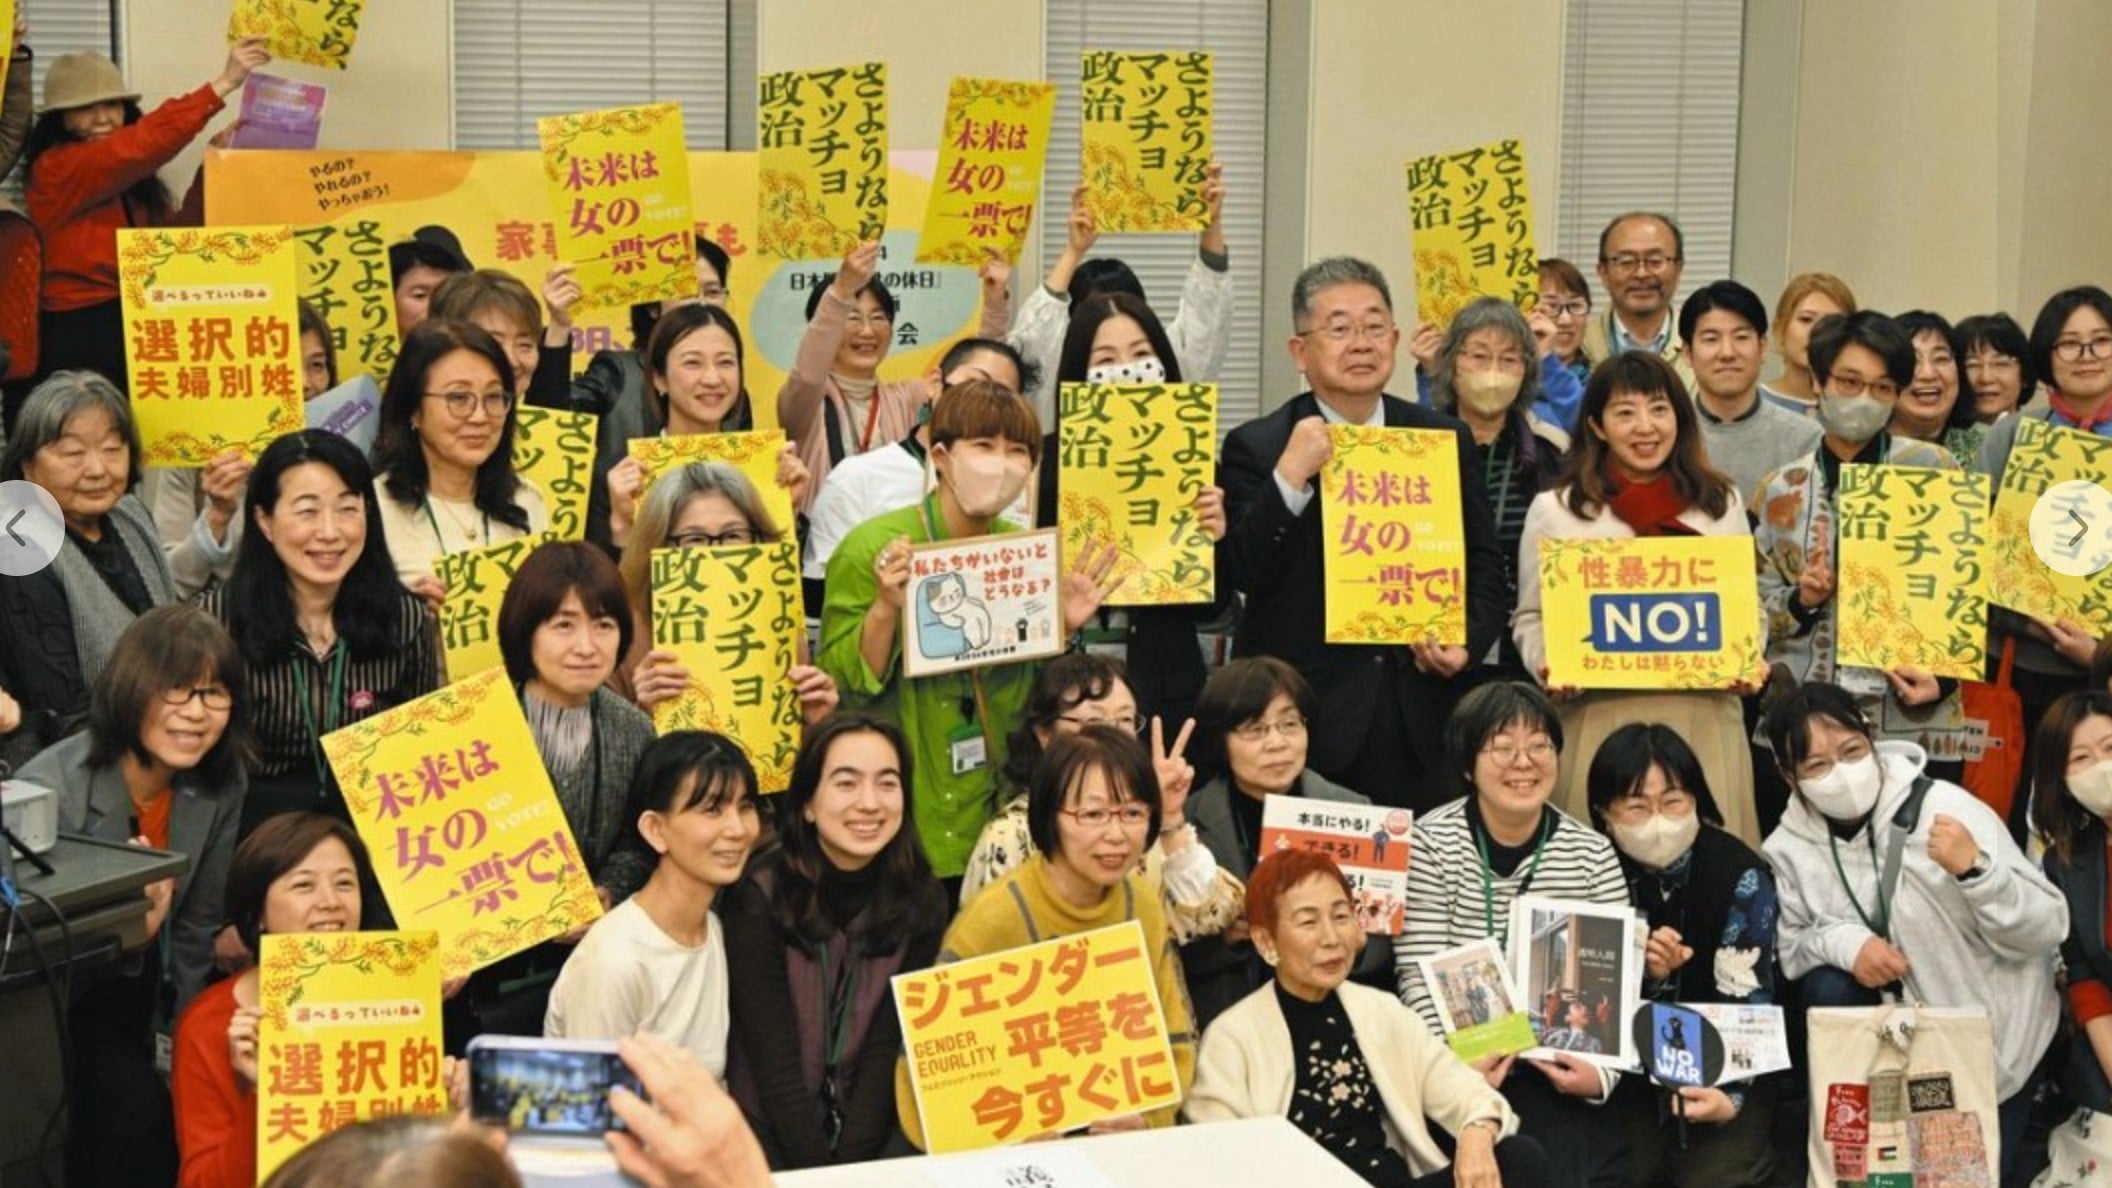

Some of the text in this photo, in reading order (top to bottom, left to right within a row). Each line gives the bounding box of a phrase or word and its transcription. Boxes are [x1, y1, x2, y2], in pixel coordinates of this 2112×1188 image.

[760, 71, 805, 148] 政治
[1082, 52, 1125, 122] 政治
[807, 67, 850, 194] マッチョ
[1128, 54, 1170, 169] マッチョ
[953, 118, 1029, 152] 未来は
[1174, 51, 1210, 229] さようなら、
[310, 158, 354, 178] やるの?
[314, 171, 371, 194] やれるの?
[563, 151, 659, 191] 未来は
[945, 157, 1005, 195] 女の
[1407, 156, 1451, 230] 政治
[1449, 148, 1495, 268] マッチョ
[565, 197, 640, 238] 女の
[572, 230, 692, 275] 一票で!
[132, 314, 290, 362] 選択的
[897, 322, 919, 345] 会
[136, 363, 297, 400] 夫婦別姓
[1061, 383, 1114, 468] 政治
[1115, 385, 1166, 527] マッチョ
[2004, 420, 2066, 497] 政治
[1336, 469, 1433, 507] 未来は
[1841, 465, 1891, 541] 政治
[1340, 514, 1411, 556] 女の
[1893, 469, 1942, 599] マッチョ
[914, 543, 1047, 577] 私たちがいないと
[984, 566, 1024, 583] 社会は
[1578, 556, 1717, 589] 性暴力に
[1945, 471, 1987, 679] さようなら、
[434, 550, 491, 650] 政治
[652, 548, 709, 644] 政治
[985, 578, 1051, 601] どうなる?
[1338, 563, 1461, 606] 一票で!
[711, 547, 765, 706] マッチョ
[1604, 601, 1708, 643] NO!
[1582, 655, 1724, 671] わたしは黙らない
[368, 739, 500, 823] 未来は
[487, 791, 513, 811] GO
[494, 799, 550, 832] VOTE!
[1299, 812, 1371, 832] 本当にやる!
[386, 808, 488, 883] 女の
[414, 831, 578, 918] 一票で!
[905, 937, 1141, 1030] ジェンダー
[913, 1030, 977, 1057] GENDER
[1004, 992, 1158, 1068] 平等を
[268, 1037, 439, 1097] 選択的
[918, 1045, 997, 1078] EQUALITY
[1656, 1058, 1700, 1083] WAR
[1662, 1046, 1694, 1066] NO
[971, 1051, 1173, 1140] 今すぐに
